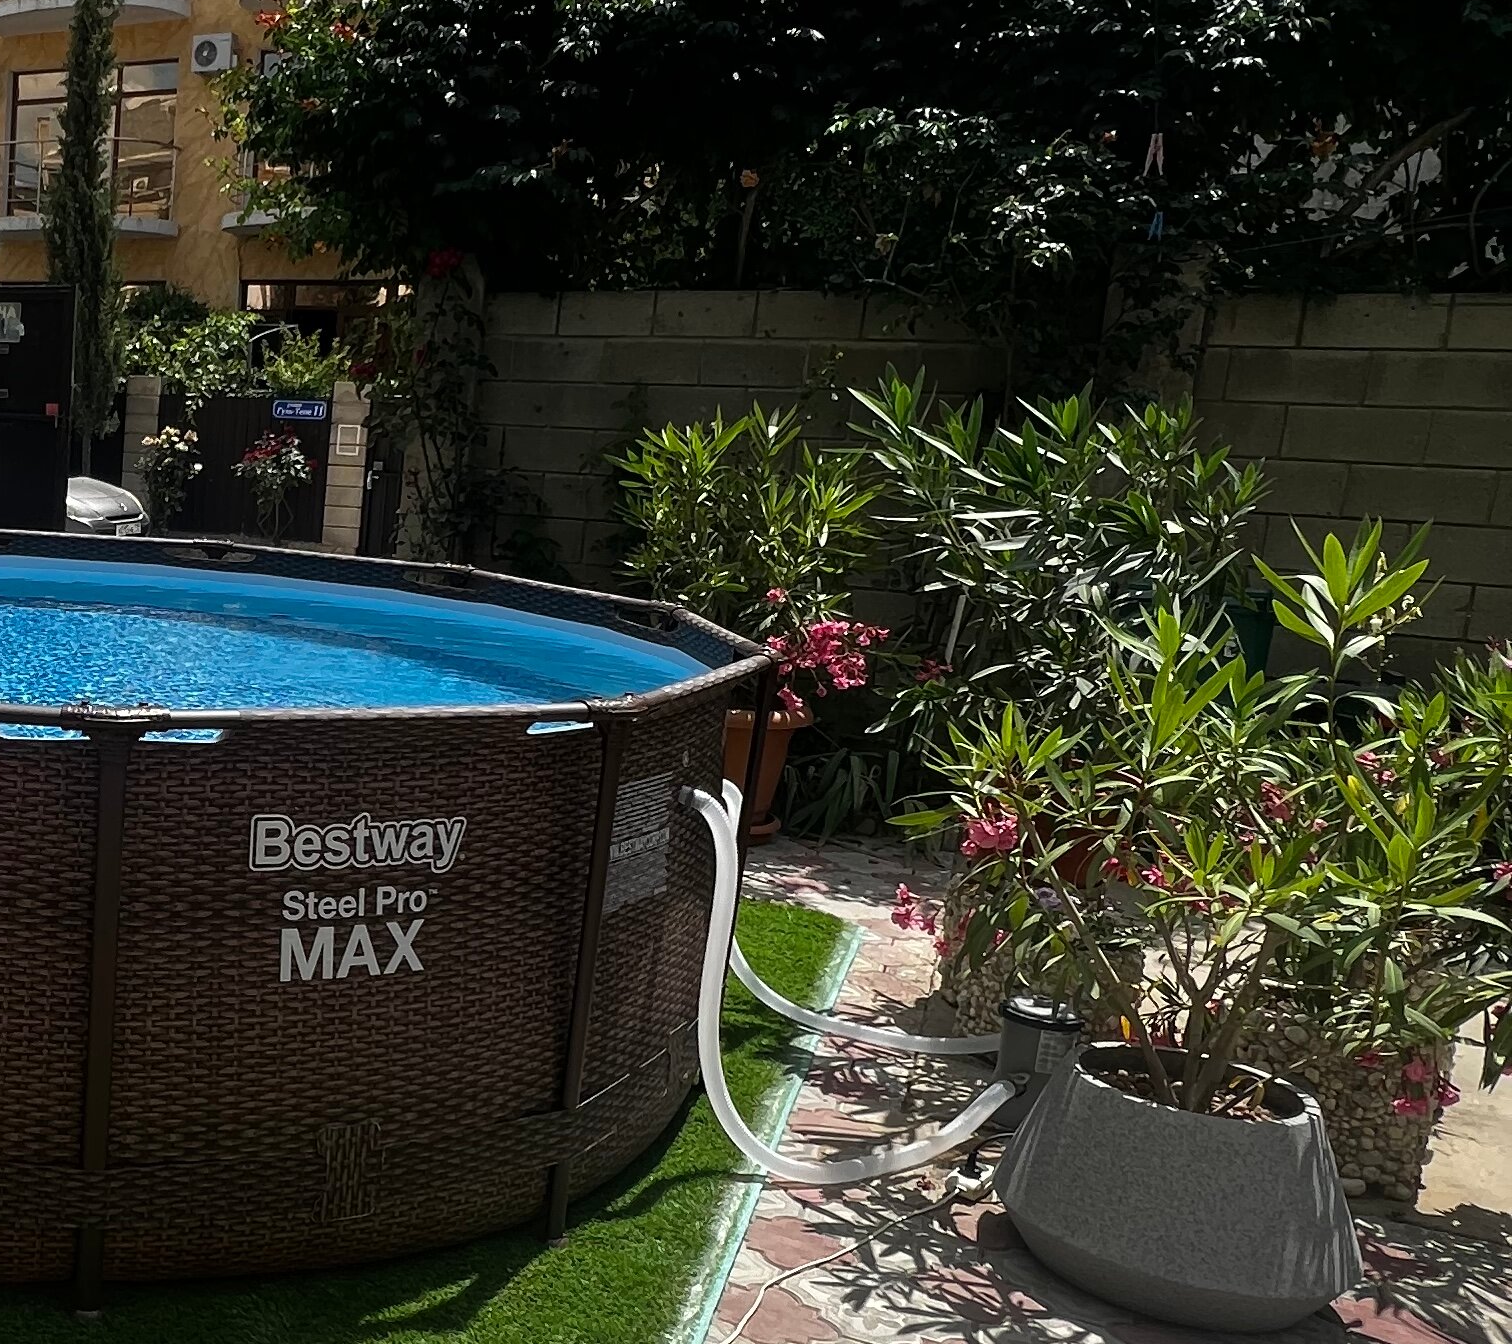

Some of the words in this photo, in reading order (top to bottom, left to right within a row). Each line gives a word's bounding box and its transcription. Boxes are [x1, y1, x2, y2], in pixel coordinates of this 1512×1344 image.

[252, 815, 464, 870] Bestway
[282, 887, 366, 921] Steel
[279, 918, 425, 982] MAX
